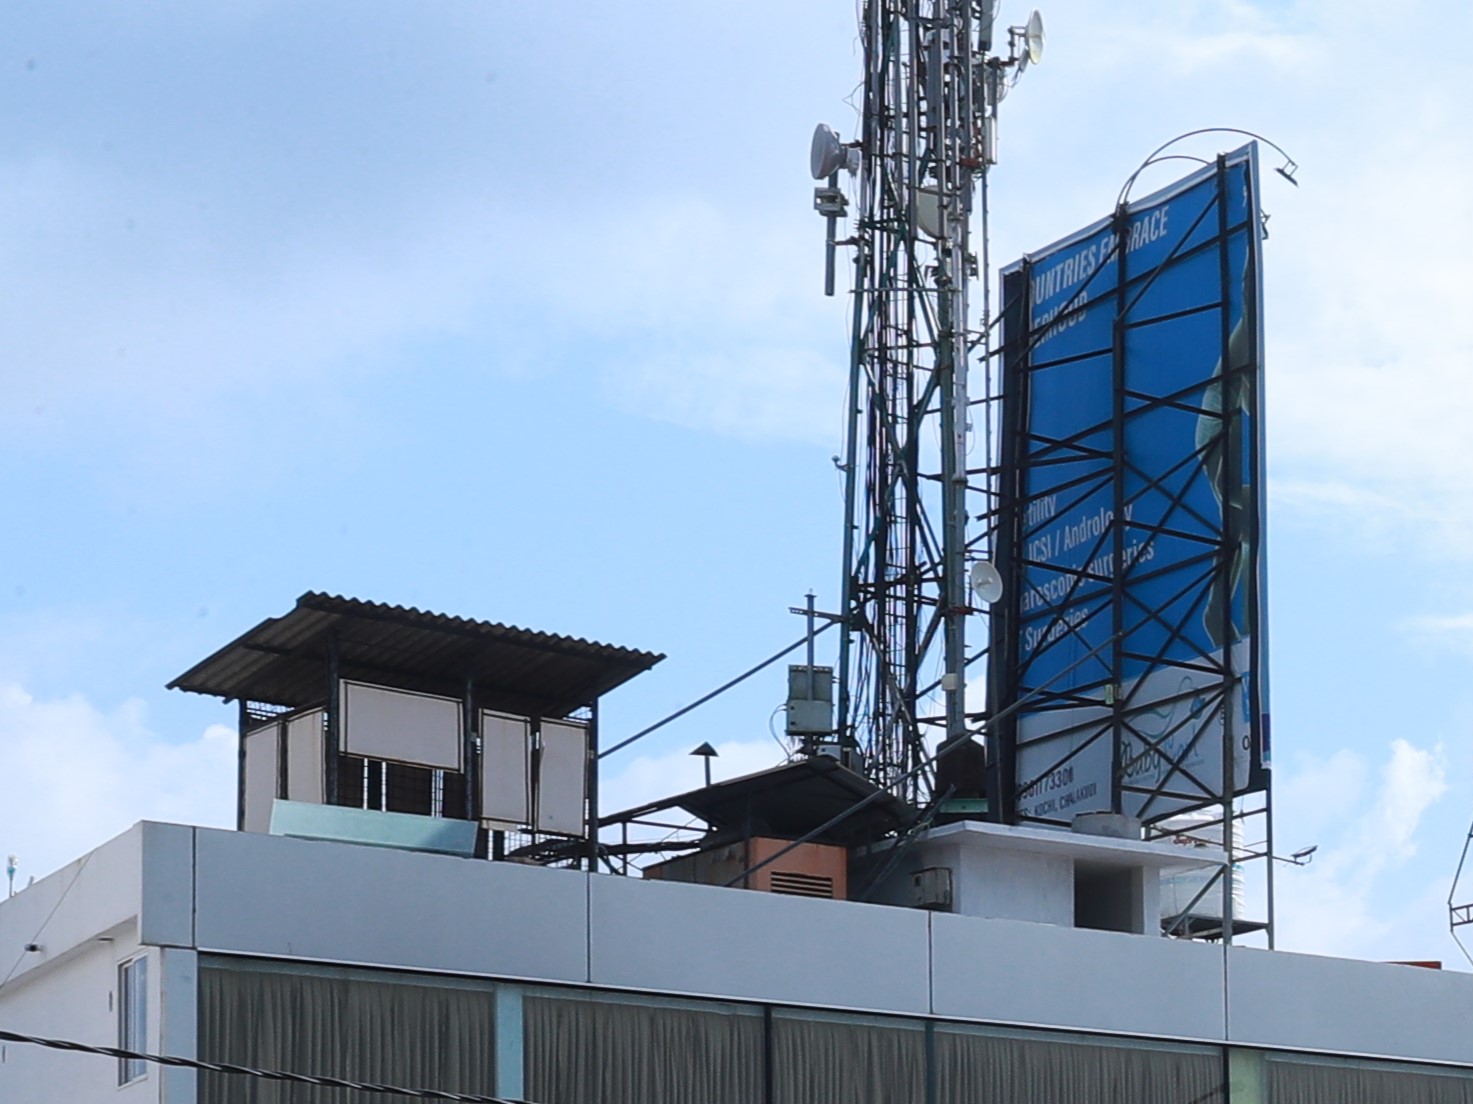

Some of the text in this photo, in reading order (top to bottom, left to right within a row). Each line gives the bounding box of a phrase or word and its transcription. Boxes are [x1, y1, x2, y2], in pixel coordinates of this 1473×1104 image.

[1030, 206, 1169, 307] UNTRIES EMRACE
[1025, 495, 1057, 527] tility
[1064, 504, 1132, 553] Androloy
